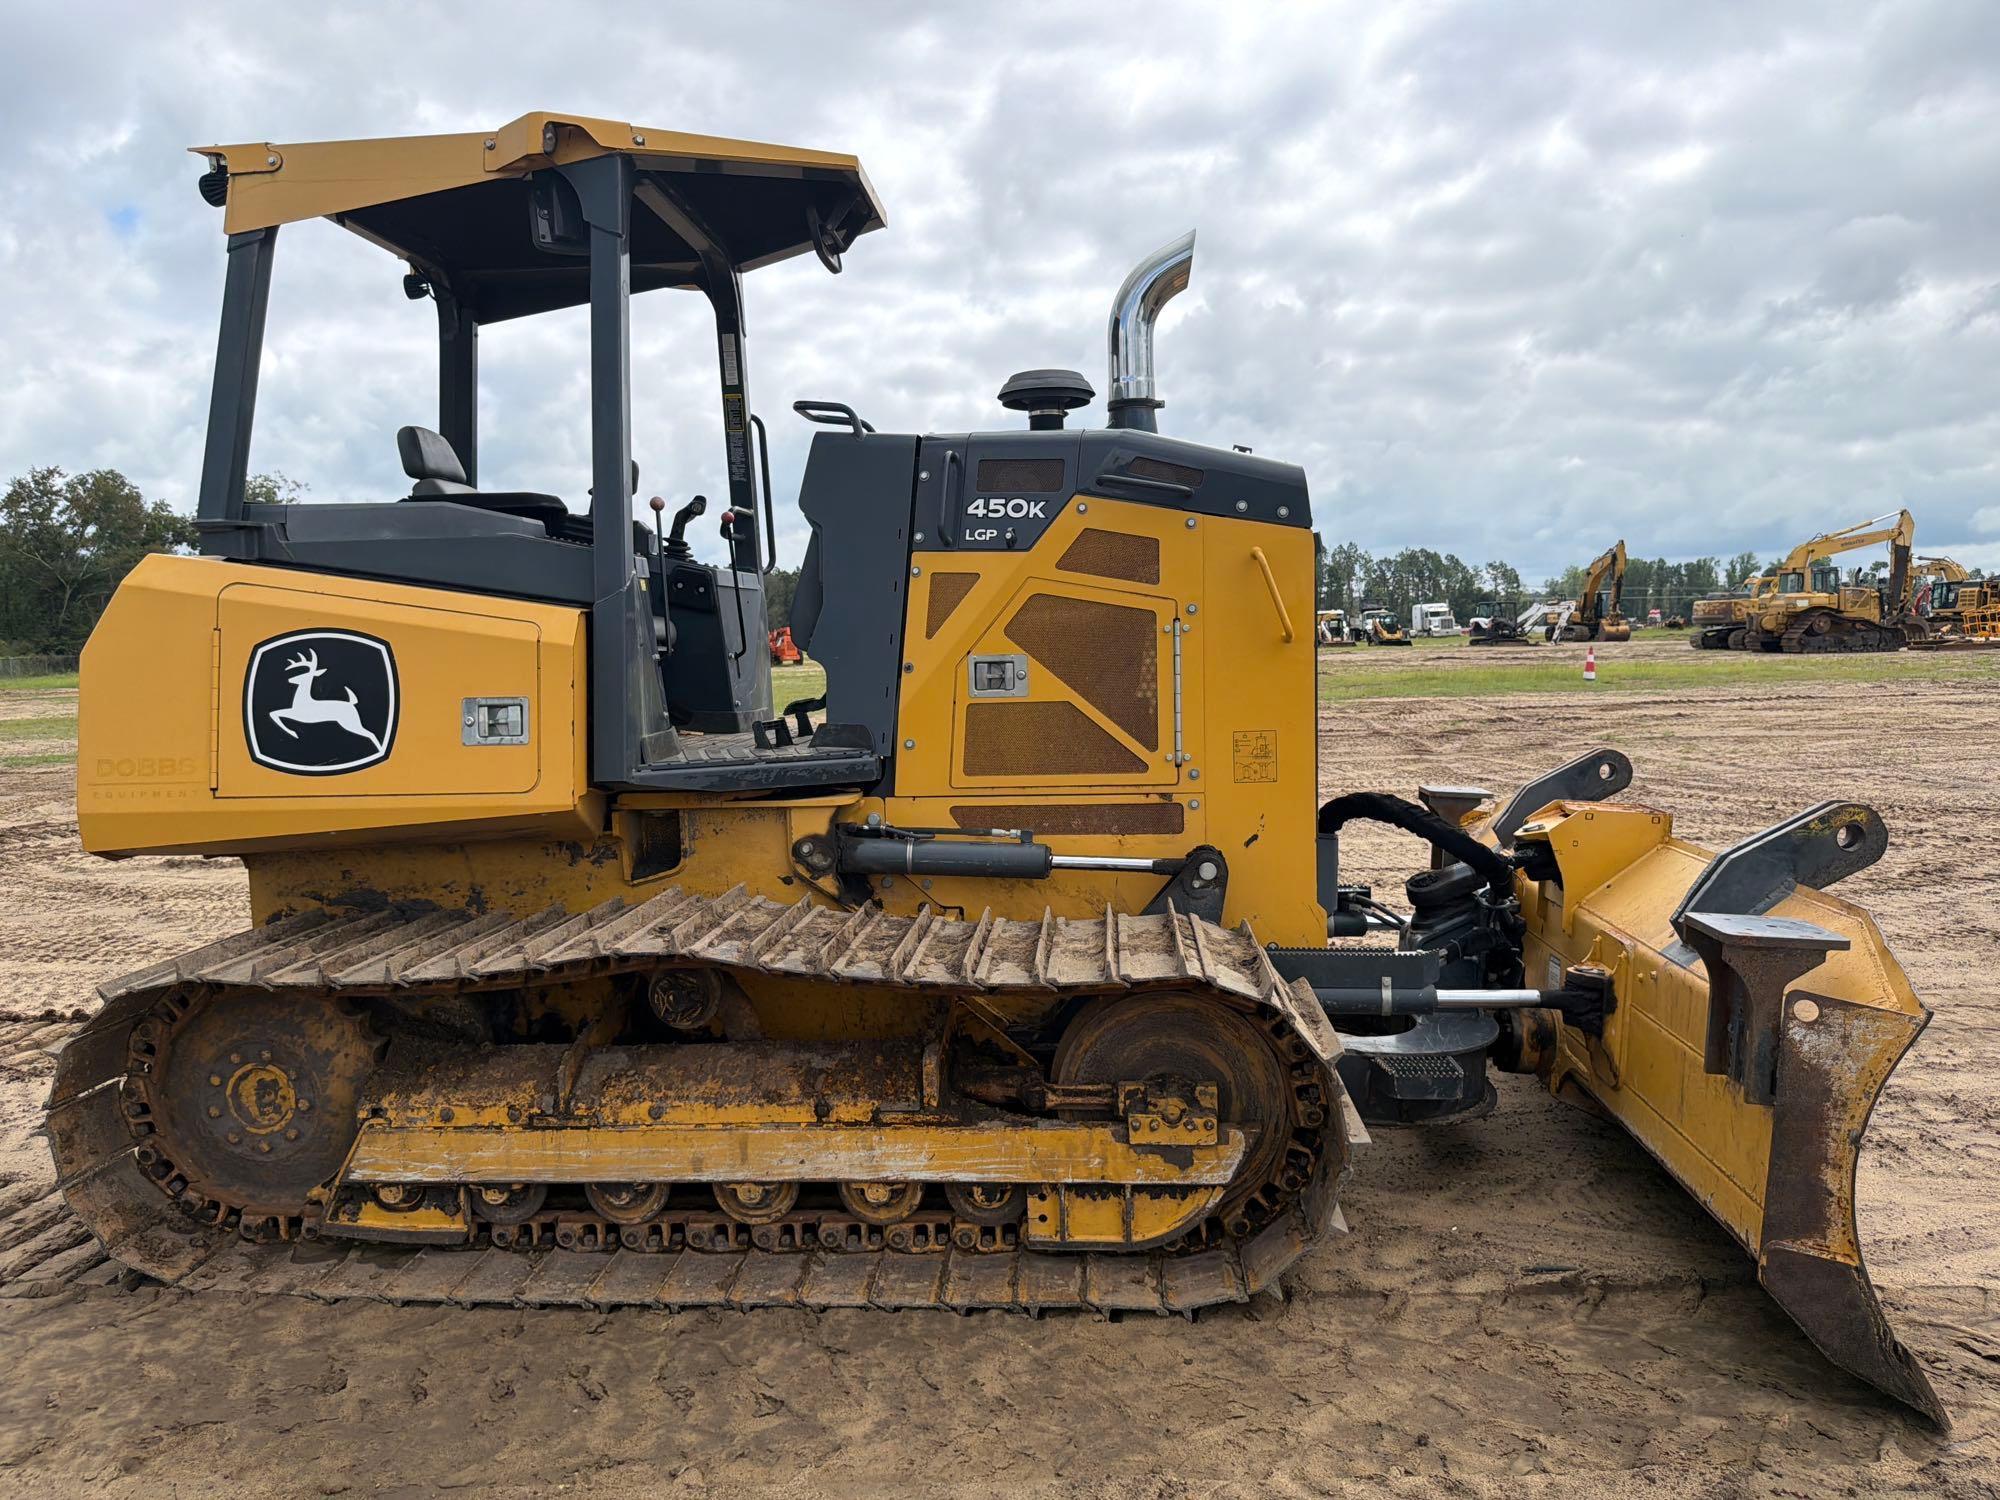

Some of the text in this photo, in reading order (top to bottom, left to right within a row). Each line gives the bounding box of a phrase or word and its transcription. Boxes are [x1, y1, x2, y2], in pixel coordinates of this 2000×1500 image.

[966, 498, 1048, 519] 450K
[965, 529, 998, 541] LGP
[96, 758, 197, 777] DOBBS
[93, 790, 199, 799] EQUIPMENT
